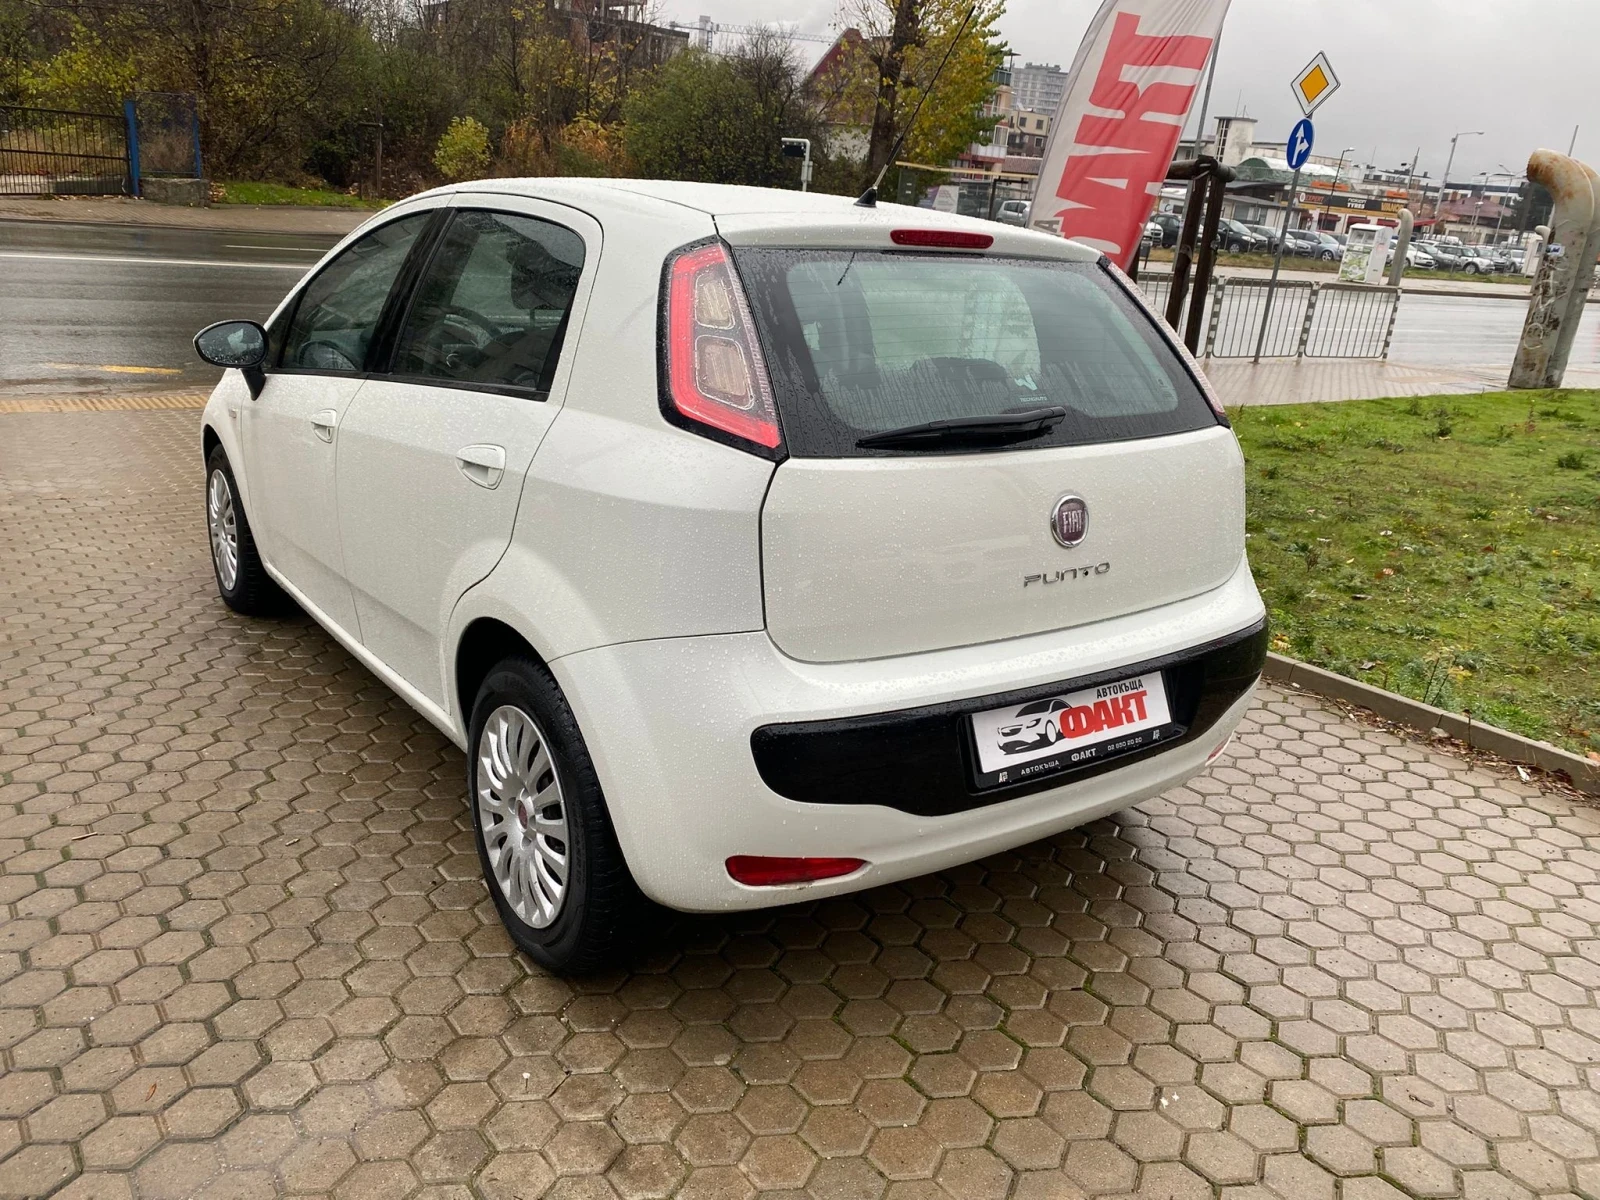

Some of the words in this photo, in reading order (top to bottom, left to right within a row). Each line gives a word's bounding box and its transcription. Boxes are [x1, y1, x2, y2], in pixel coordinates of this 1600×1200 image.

[1062, 509, 1083, 534] FIAT
[1024, 562, 1110, 588] PUNTO
[1096, 679, 1144, 699] АВТОКЪЩА
[1059, 690, 1148, 739] ФАКТ
[1071, 748, 1096, 762] ФАКТ
